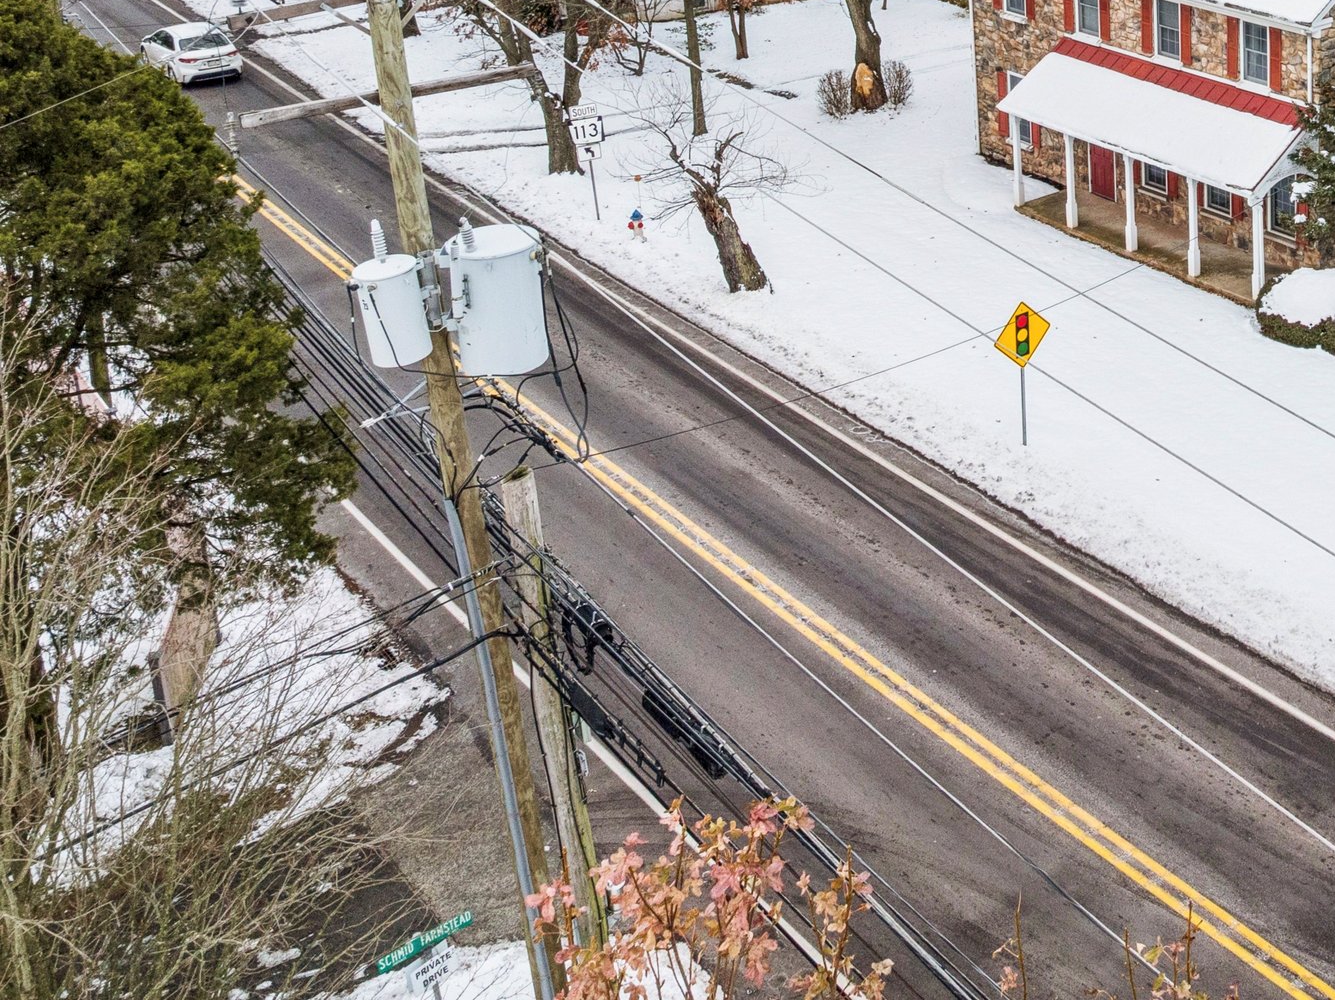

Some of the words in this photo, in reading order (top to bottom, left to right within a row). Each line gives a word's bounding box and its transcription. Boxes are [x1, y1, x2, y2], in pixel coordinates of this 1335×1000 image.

[572, 106, 595, 117] SOUTH
[574, 123, 598, 139] 113
[378, 942, 414, 970] SCHMID
[420, 911, 472, 946] FARMSTEAD
[415, 951, 452, 980] PRIVATE
[423, 965, 449, 987] DRIVE
